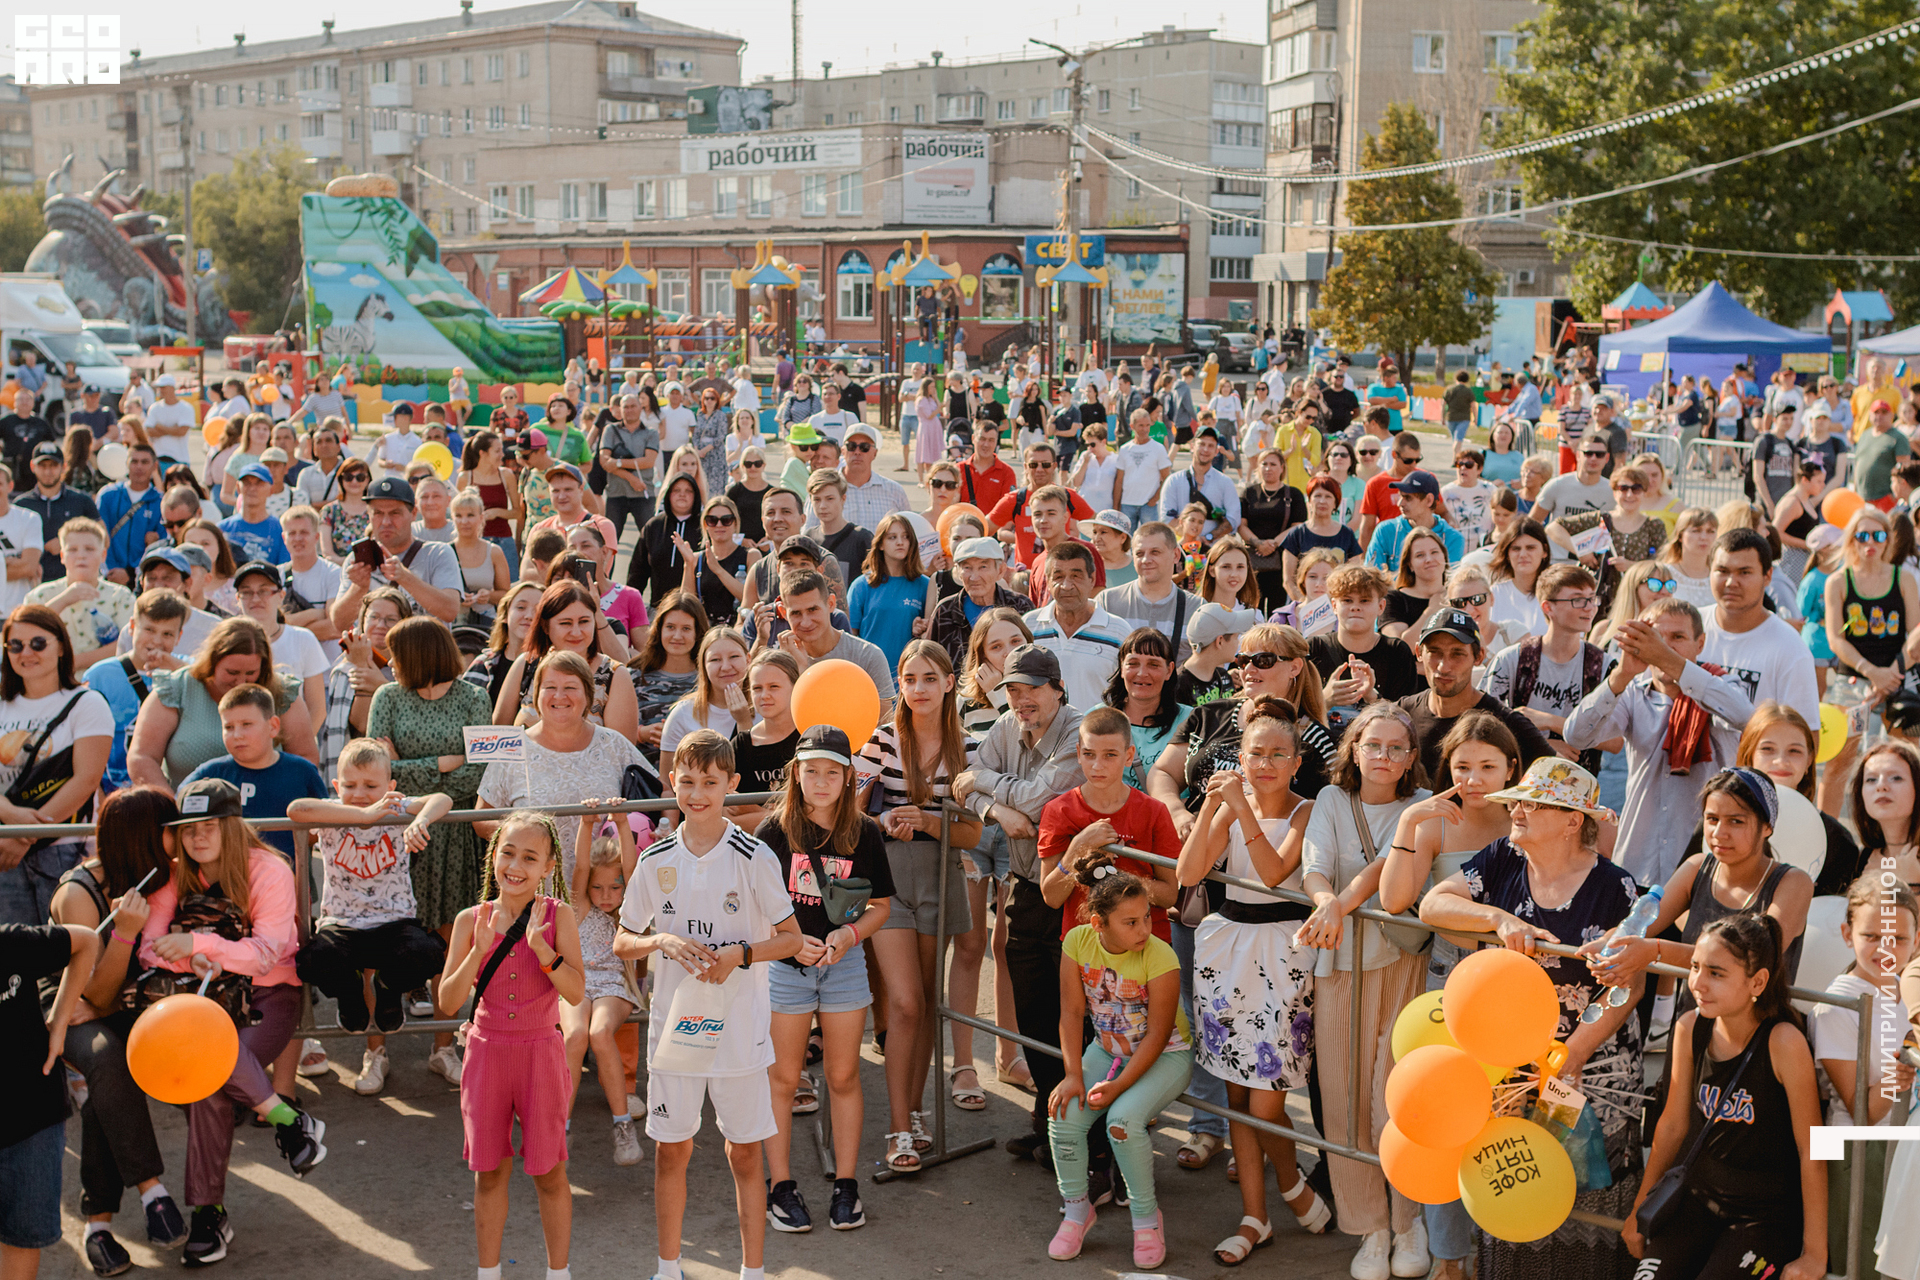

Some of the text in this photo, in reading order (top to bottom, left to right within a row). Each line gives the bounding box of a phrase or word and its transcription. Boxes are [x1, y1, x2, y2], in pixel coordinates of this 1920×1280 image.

[708, 137, 817, 170] рабочий
[905, 140, 984, 159] рабочий
[1123, 289, 1164, 300] НАМИ
[754, 768, 785, 782] VOG
[335, 833, 396, 878] MARVEL
[687, 919, 713, 938] Fly
[1548, 1081, 1567, 1099] Uno
[1473, 1135, 1528, 1164] НИЦА
[1496, 1148, 1534, 1174] ПЯТ
[1489, 1164, 1541, 1197] КОФЕ
